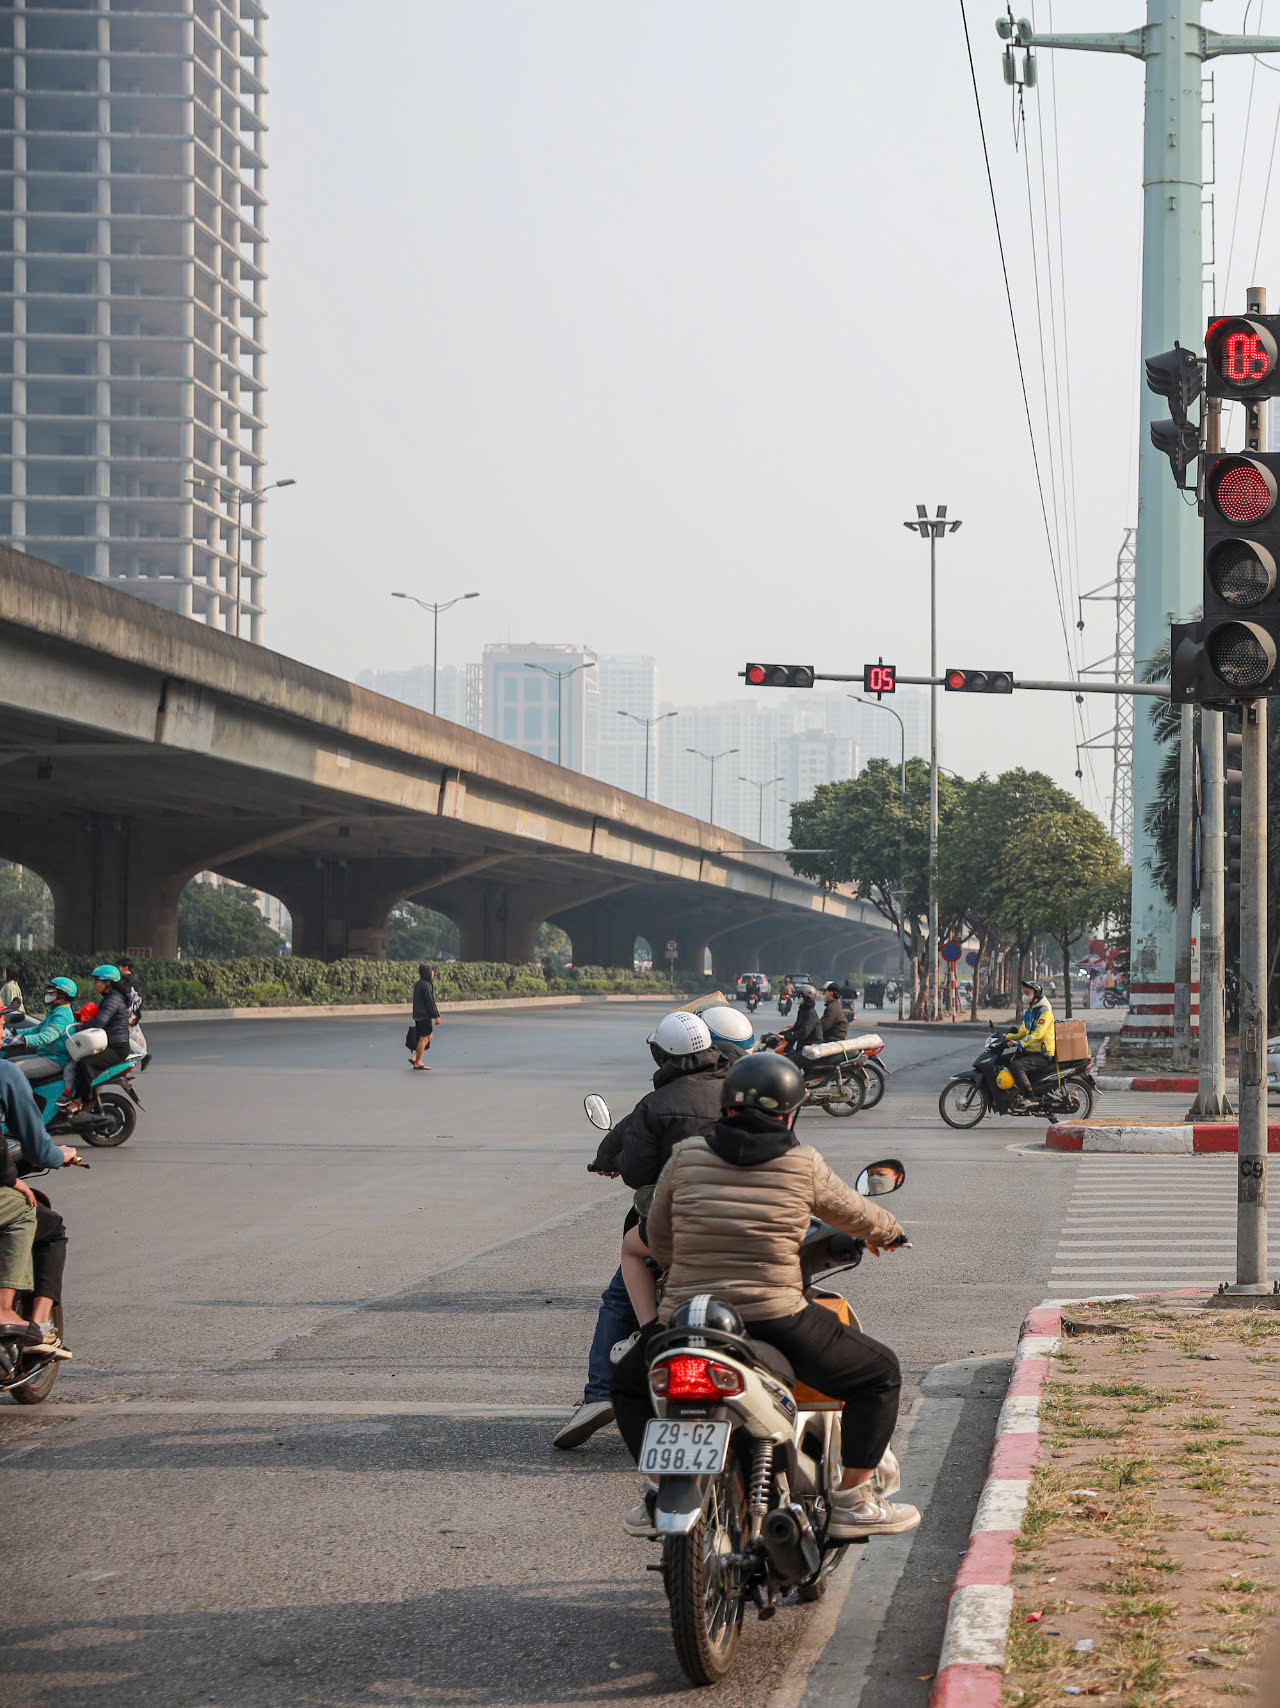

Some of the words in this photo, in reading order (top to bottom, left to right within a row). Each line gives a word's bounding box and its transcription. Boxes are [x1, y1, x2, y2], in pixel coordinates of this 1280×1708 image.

[1227, 333, 1270, 380] 05
[869, 667, 894, 691] 05
[656, 1423, 716, 1446] 29-G2
[645, 1448, 719, 1470] 098.42
